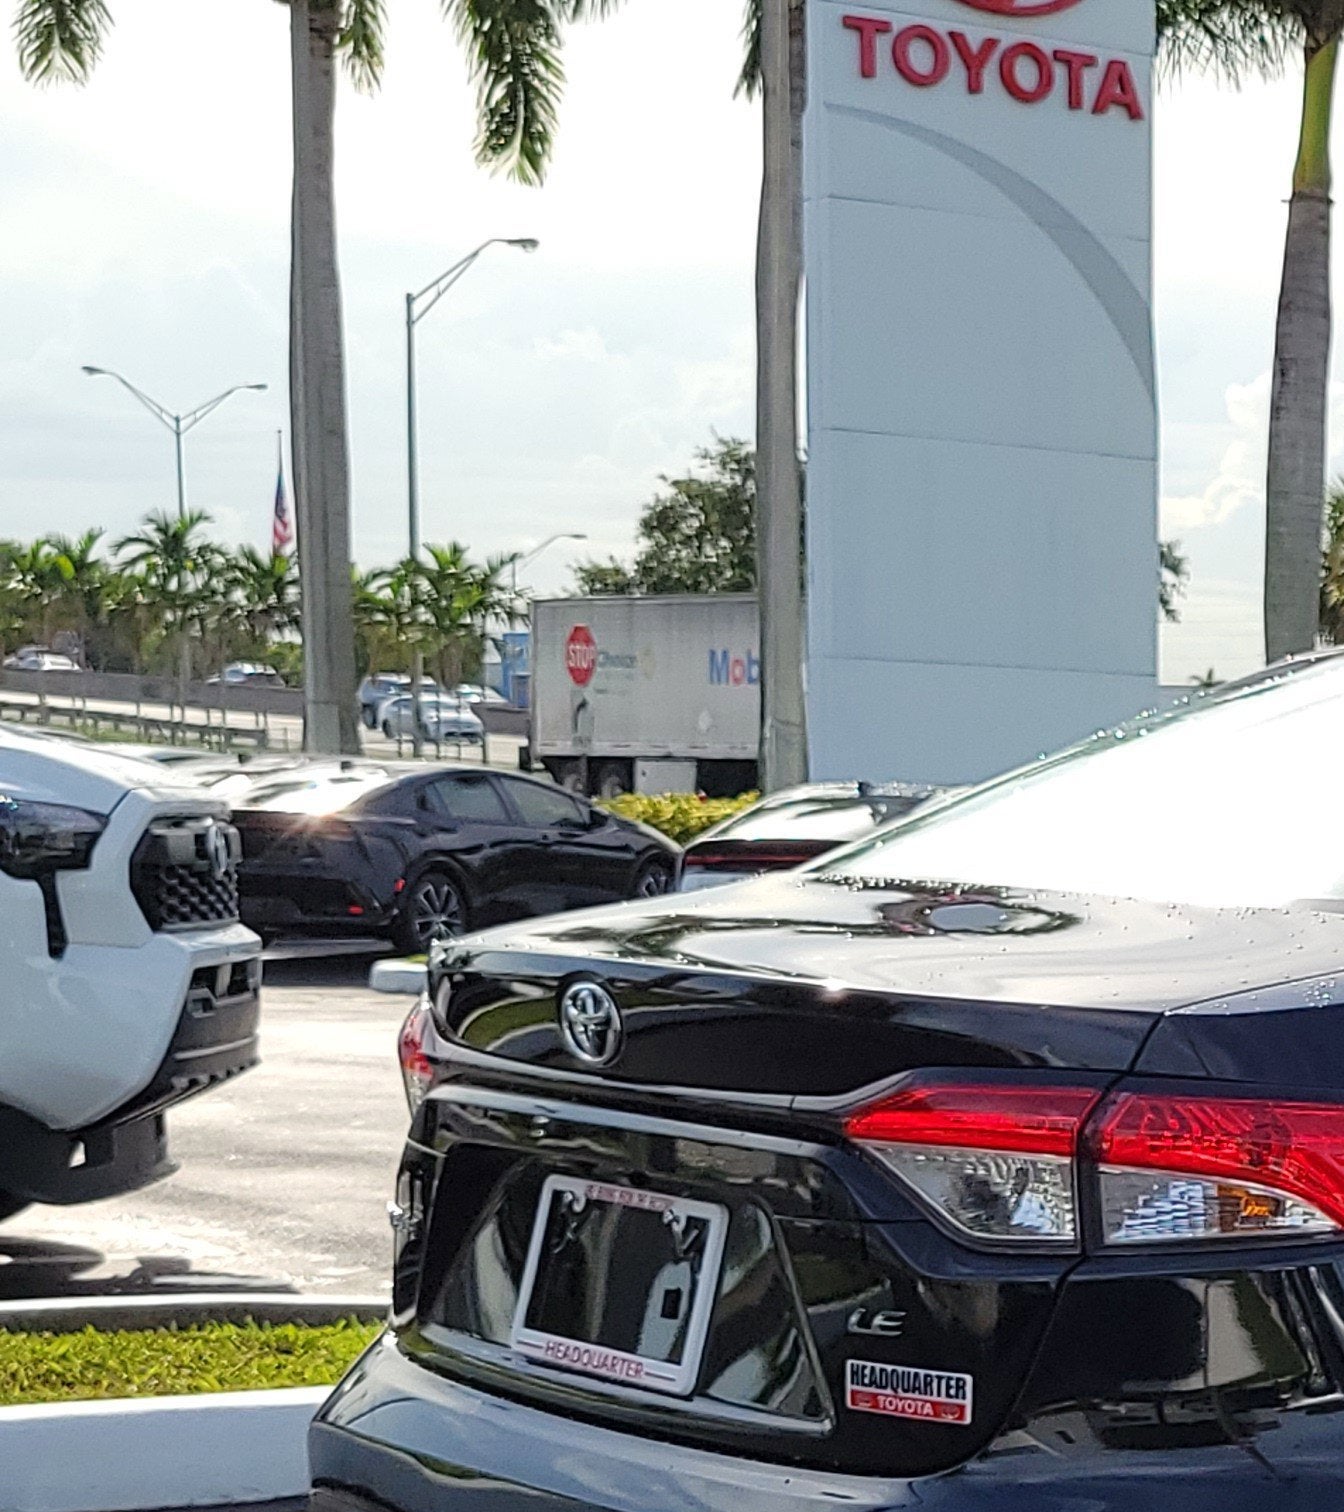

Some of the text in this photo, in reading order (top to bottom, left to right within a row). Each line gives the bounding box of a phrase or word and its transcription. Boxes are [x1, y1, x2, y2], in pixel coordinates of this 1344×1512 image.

[843, 15, 1144, 121] TOYOTA
[568, 644, 595, 670] STOP
[847, 1308, 907, 1336] LE
[544, 1341, 644, 1378] HEADQUARTER
[850, 1362, 967, 1400] HEADQUARTER
[877, 1395, 934, 1416] TOYOTA
